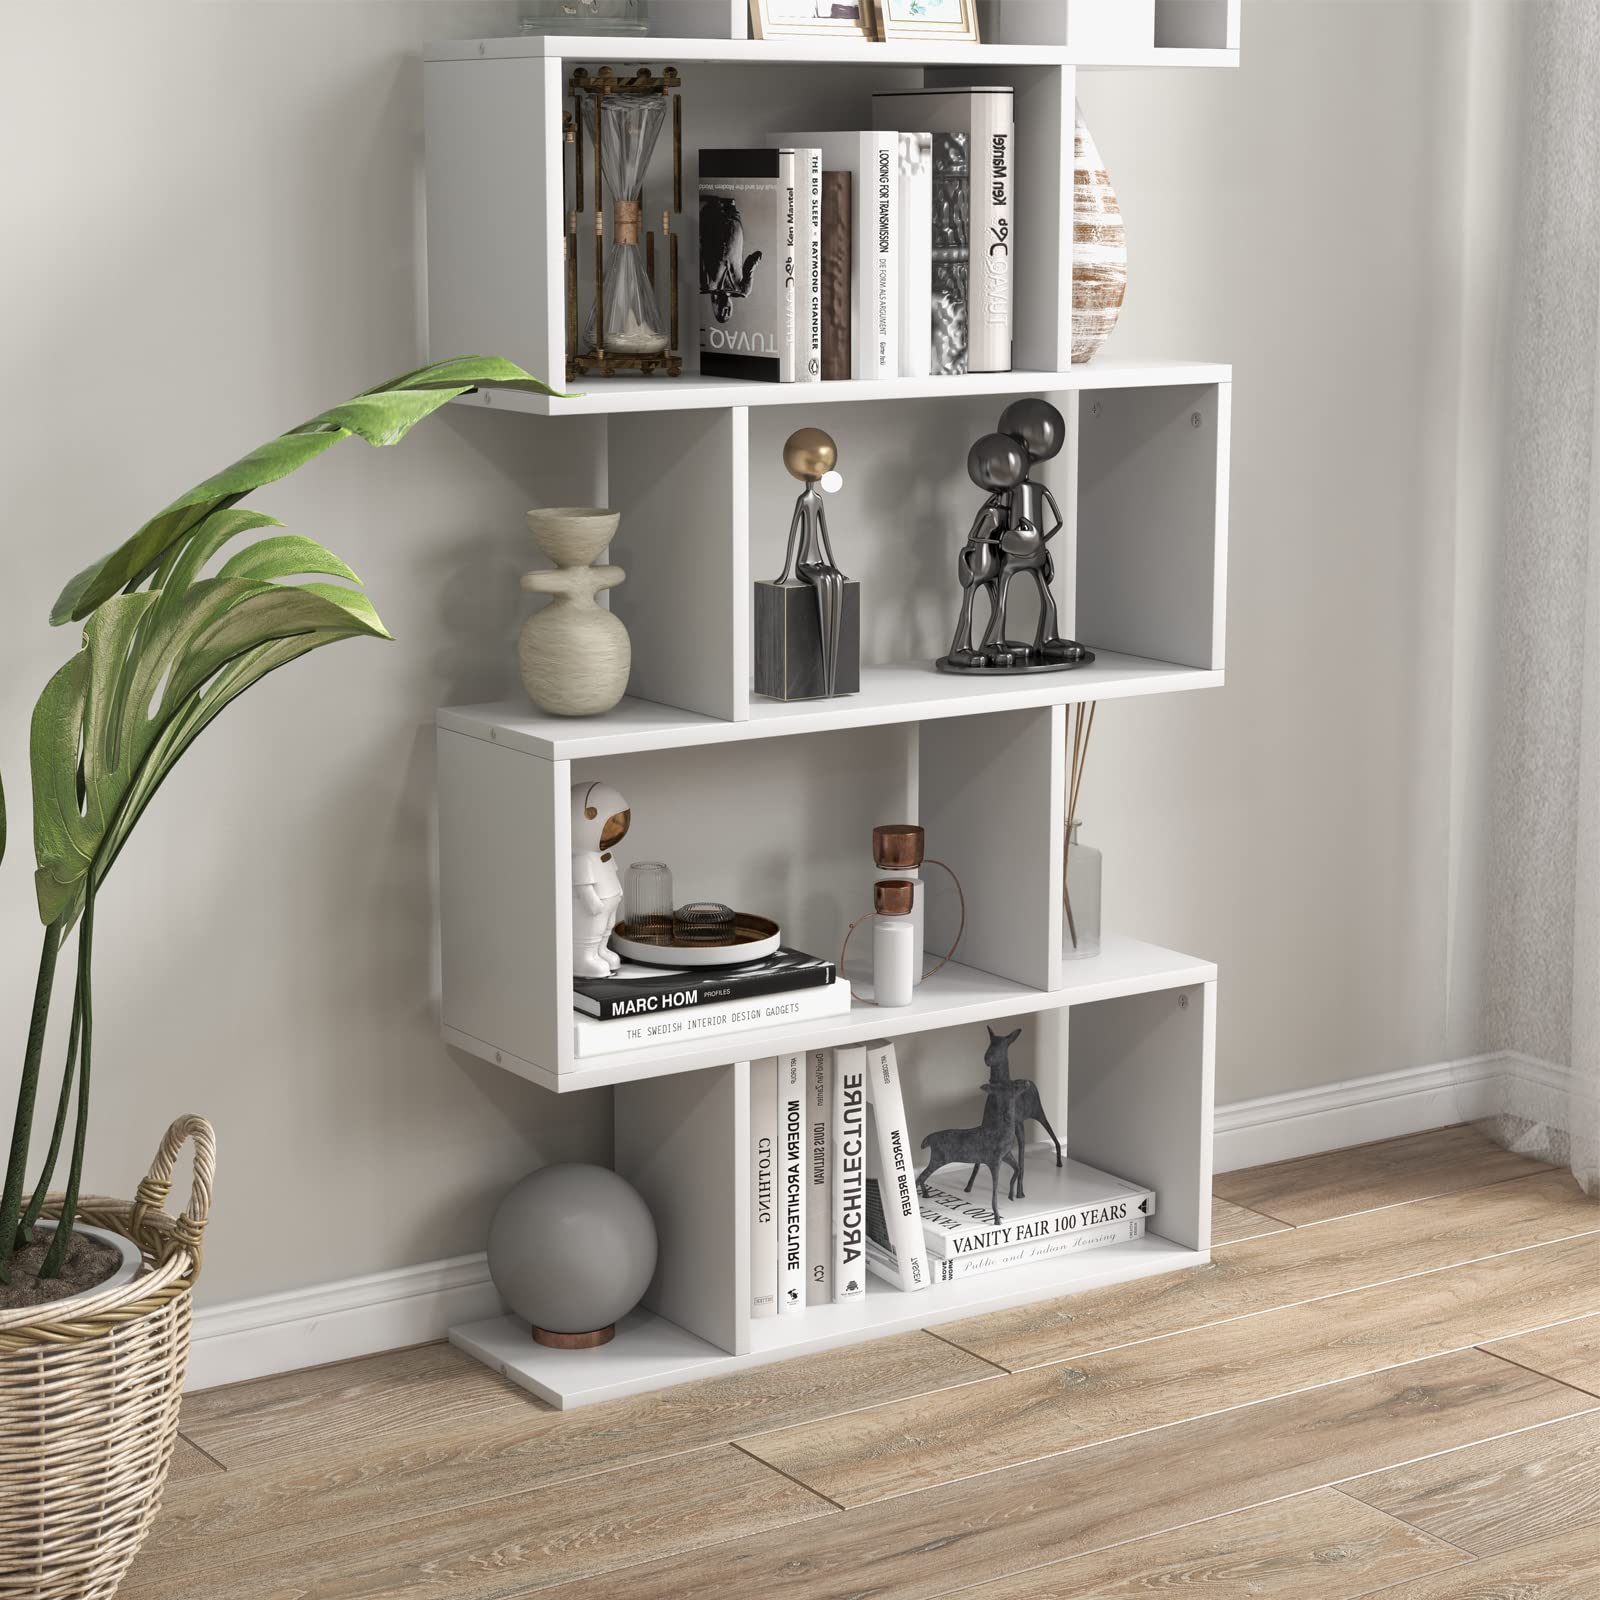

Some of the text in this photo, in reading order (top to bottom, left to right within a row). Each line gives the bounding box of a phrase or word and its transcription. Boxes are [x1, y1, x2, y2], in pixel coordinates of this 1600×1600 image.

[786, 187, 794, 247] Ken Mantel
[878, 150, 889, 253] LOOKING FOR TRANSMISSION
[709, 326, 778, 354] TUVAQ
[612, 988, 731, 1016] MARC HOM PROFILES
[627, 1002, 800, 1040] THE SWEDISH INTERIOR DESIGN GADGETS
[953, 1204, 1128, 1254] VANITY FAIR 100 YEARS
[964, 1231, 1117, 1272] Public and Indian Housing
